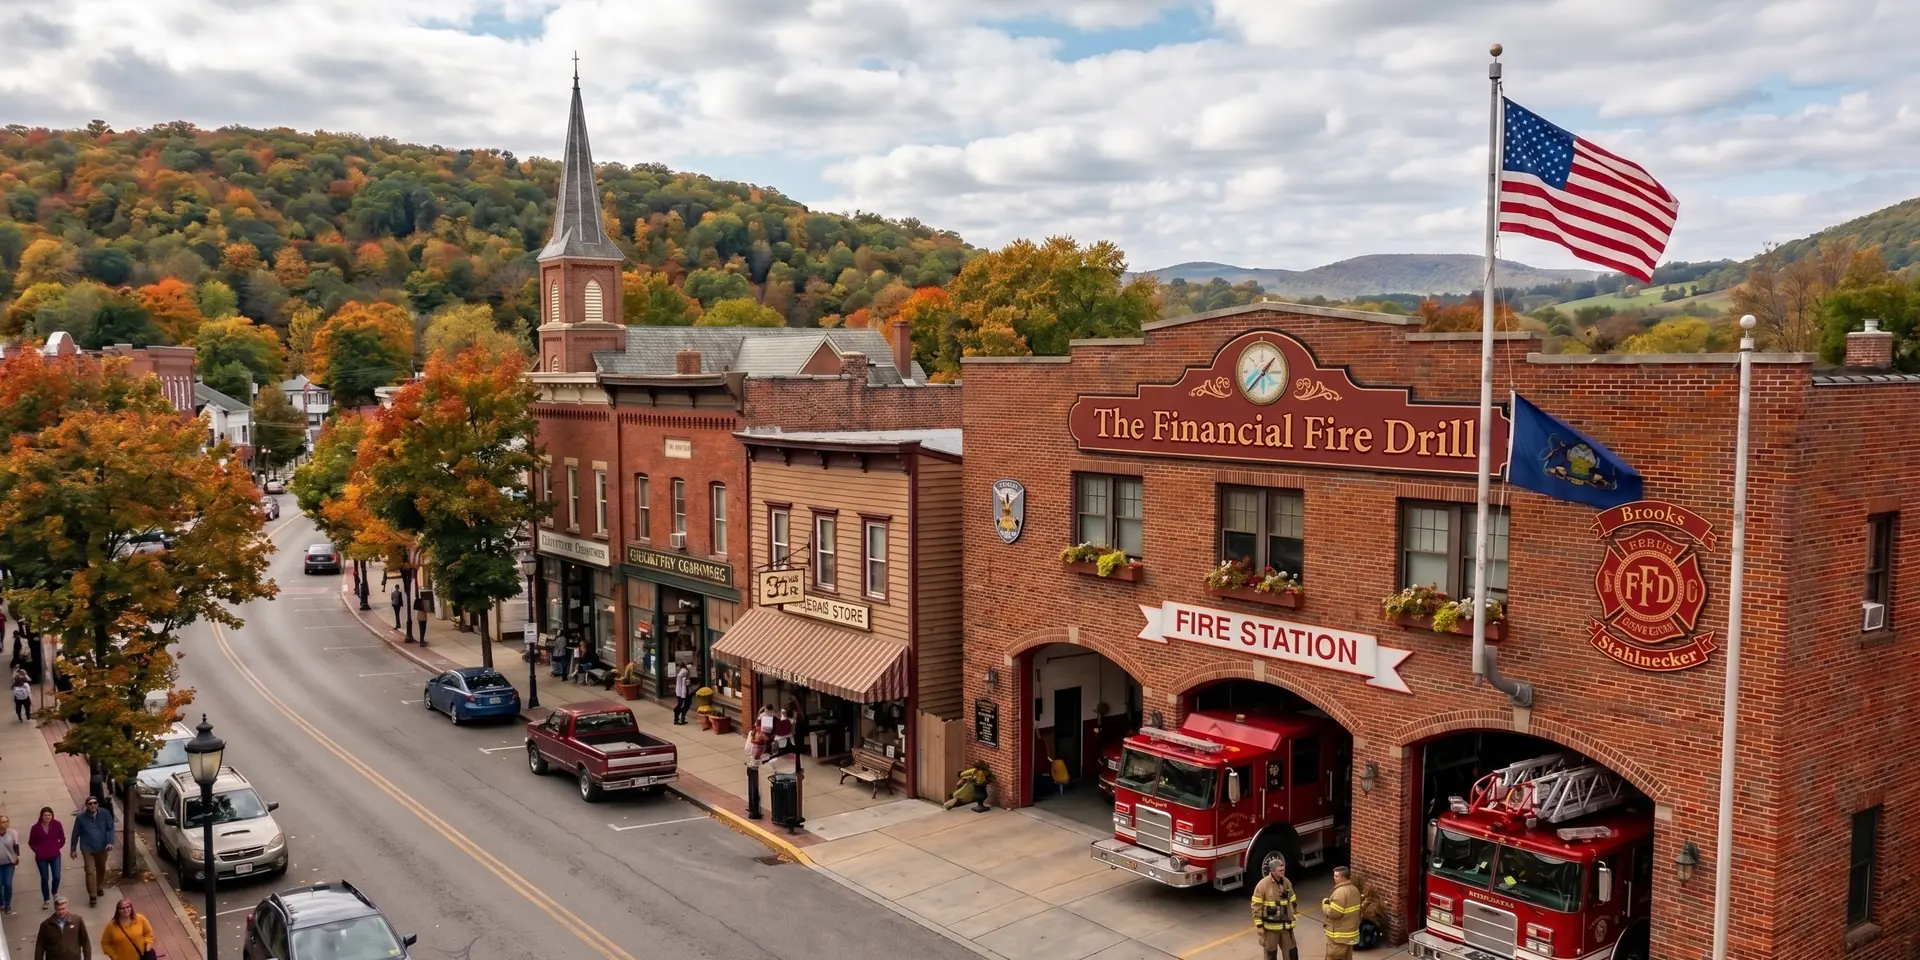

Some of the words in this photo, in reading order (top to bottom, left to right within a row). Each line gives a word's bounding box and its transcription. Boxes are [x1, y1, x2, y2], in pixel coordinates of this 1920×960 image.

[1094, 407, 1145, 441] The
[1152, 410, 1294, 449] Financial
[1304, 416, 1373, 453] Fire
[1384, 419, 1477, 458] Drill
[1621, 506, 1685, 526] Brooks
[1626, 566, 1674, 607] FFD
[832, 604, 864, 624] STORE
[1176, 609, 1231, 642] FIRE
[1240, 620, 1358, 665] STATION
[1599, 637, 1697, 667] Stahlnecker
